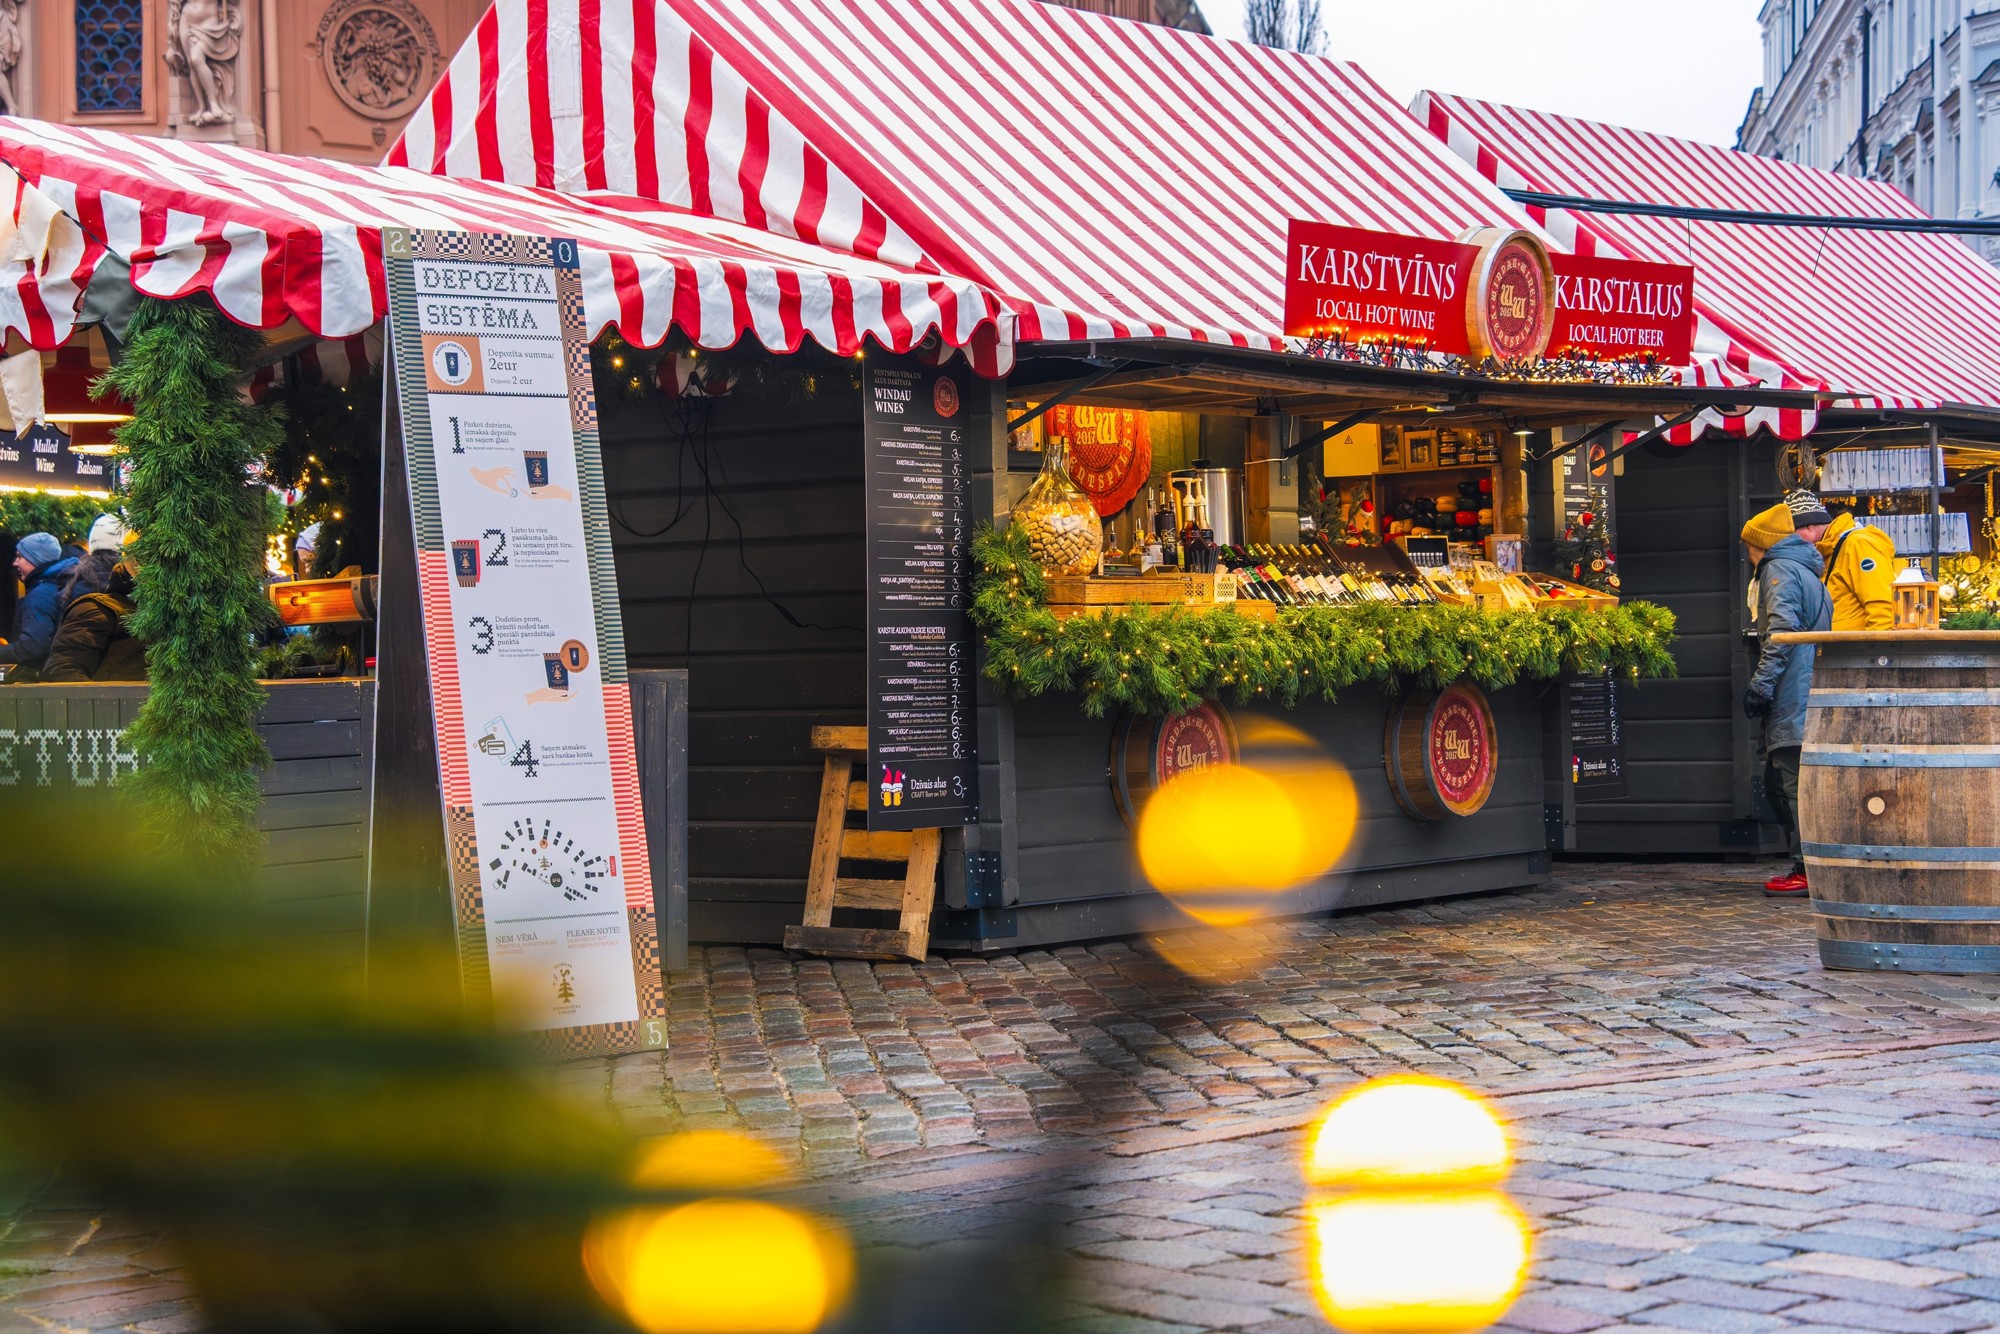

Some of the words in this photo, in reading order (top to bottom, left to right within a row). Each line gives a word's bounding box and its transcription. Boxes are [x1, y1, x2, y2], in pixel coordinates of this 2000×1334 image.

[389, 231, 406, 254] 2
[422, 267, 551, 295] DEPOZĪTA
[1298, 244, 1457, 303] KARSTVĪNS
[1554, 274, 1683, 321] KARSTALUS
[426, 302, 538, 330] SISTĒMA
[1315, 298, 1362, 324] LOCAL
[1365, 304, 1397, 326] HOT
[1399, 307, 1435, 331] WINE
[1569, 323, 1606, 345] LOCAL
[1609, 328, 1636, 345] HOT
[1638, 329, 1664, 347] BEER
[487, 348, 523, 358] Depozīta
[524, 351, 554, 359] summa:
[488, 358, 518, 371] 2eur
[874, 387, 912, 401] WINDAU
[874, 401, 904, 414] WINES
[33, 438, 59, 454] Mulled
[449, 416, 465, 454] 1
[1076, 431, 1096, 444] 2017
[36, 457, 56, 473] Wine
[76, 460, 103, 476] Balsam
[482, 528, 509, 566] 2
[469, 616, 494, 655] 3
[510, 740, 539, 778] 4
[911, 779, 933, 790] Dzīvais
[934, 776, 947, 788] alus
[566, 928, 597, 938] PLEASE
[597, 926, 620, 936] NOTE!
[647, 1022, 662, 1045] 5
